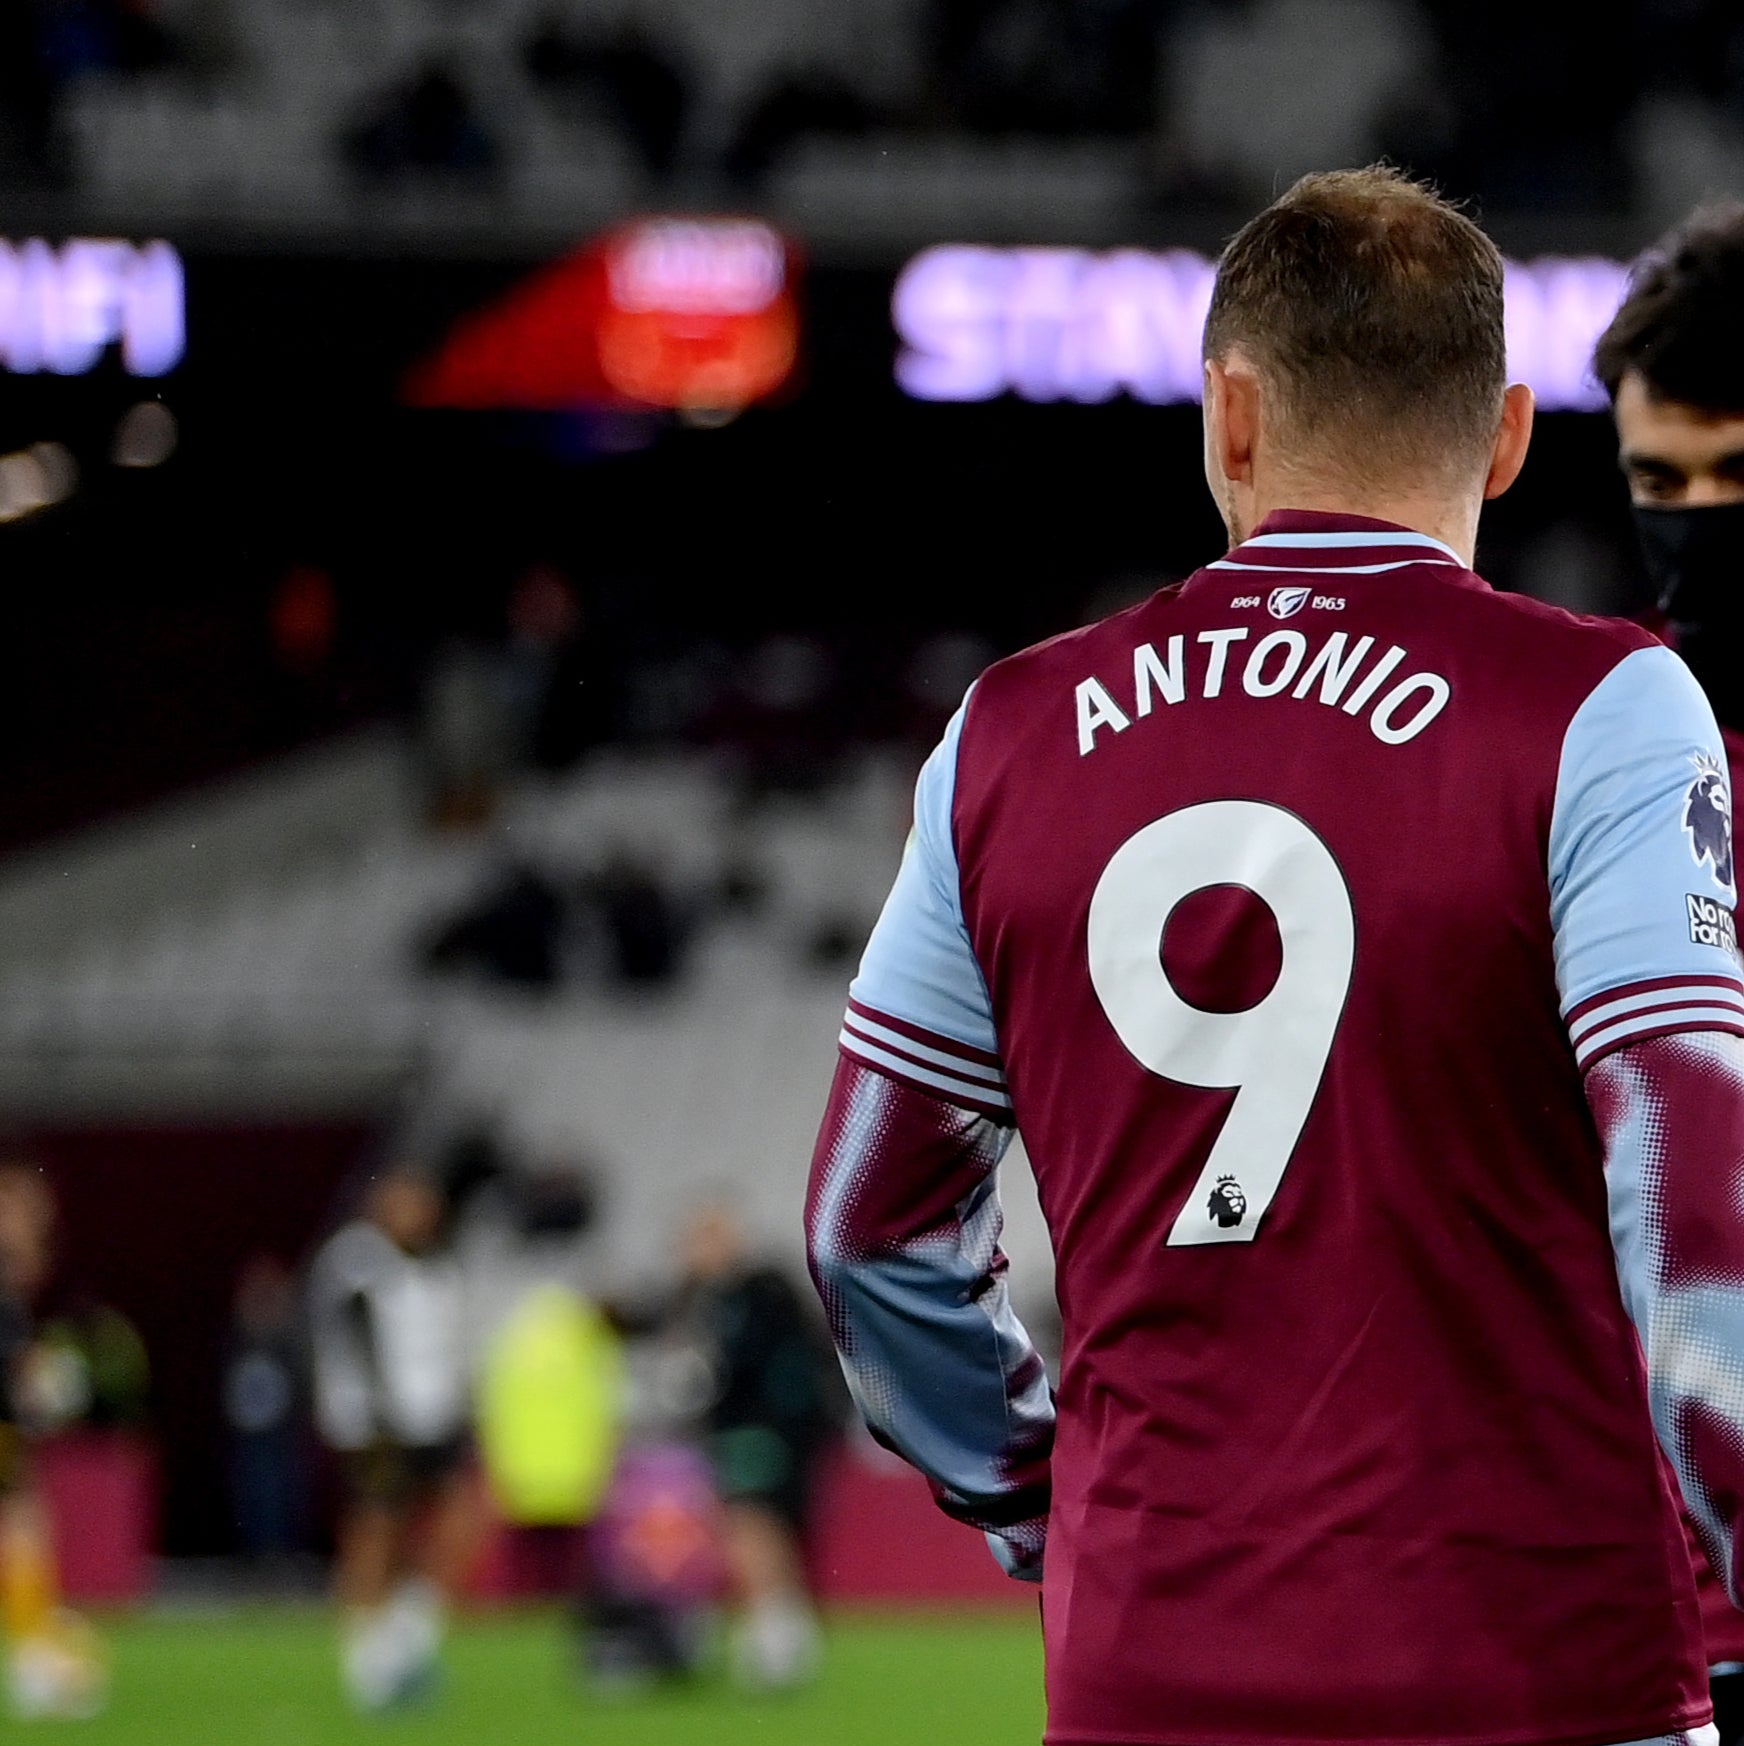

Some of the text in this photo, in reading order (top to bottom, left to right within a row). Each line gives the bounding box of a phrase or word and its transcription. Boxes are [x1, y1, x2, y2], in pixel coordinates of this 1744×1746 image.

[1230, 595, 1347, 611] 1964 1965
[1074, 626, 1451, 757] ANTONIO
[1686, 894, 1717, 924] No
[1690, 917, 1718, 946] for
[1086, 798, 1356, 1247] 9
